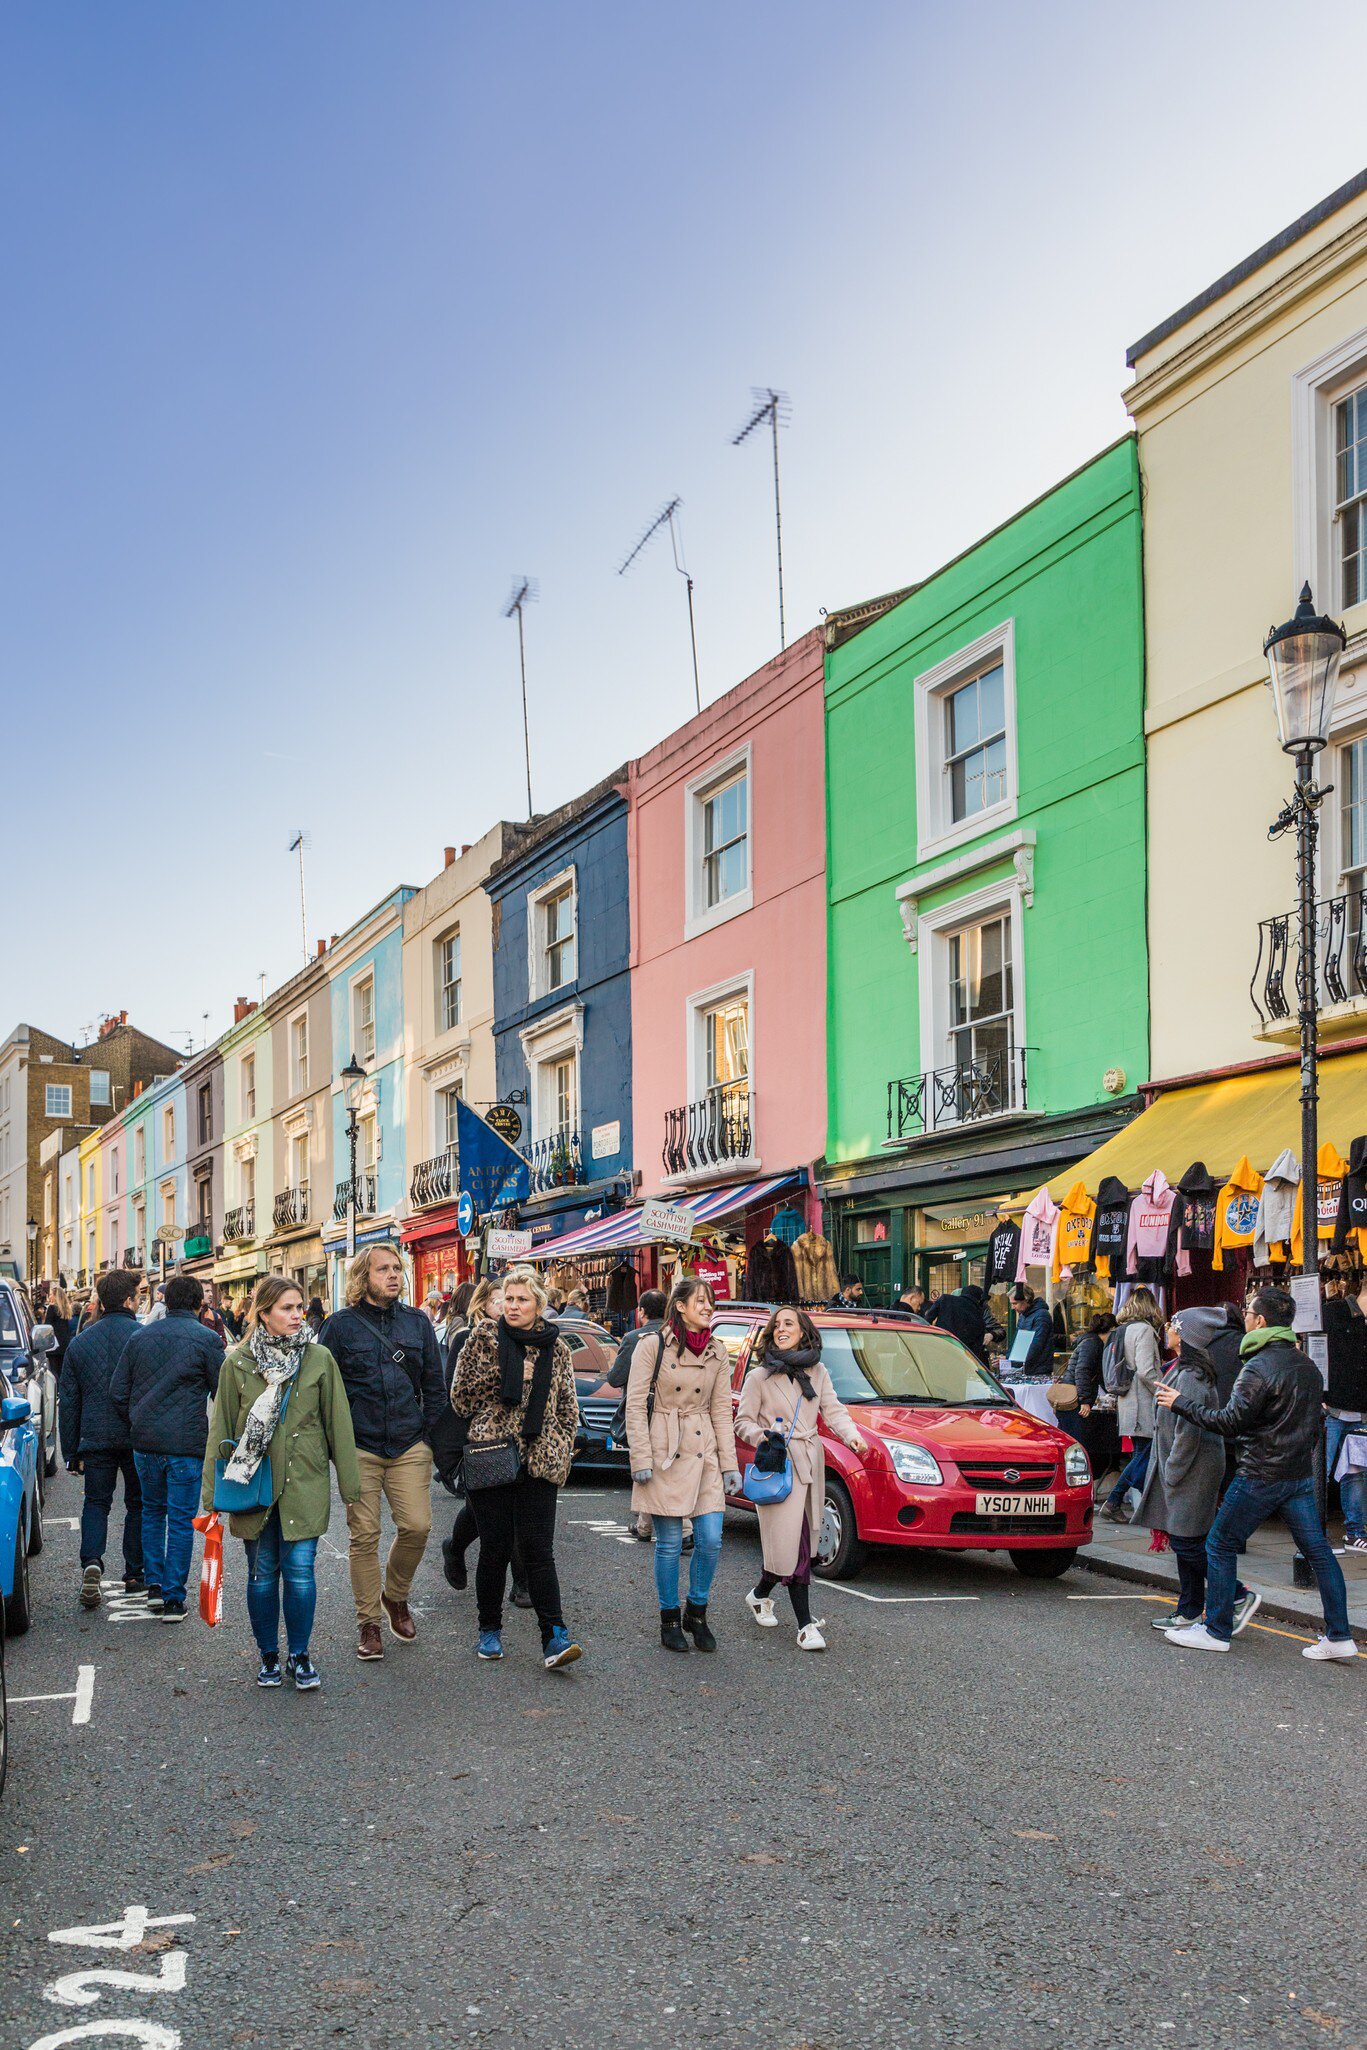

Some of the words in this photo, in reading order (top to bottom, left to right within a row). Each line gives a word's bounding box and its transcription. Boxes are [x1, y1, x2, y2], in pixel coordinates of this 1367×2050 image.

[467, 1164, 521, 1177] ANTIQUE
[650, 1209, 688, 1224] SCOTTISH
[941, 1216, 970, 1231] Gallery
[974, 1213, 984, 1227] 91
[1141, 1213, 1169, 1227] LONDON
[646, 1218, 688, 1235] CASHMERE
[1066, 1217, 1093, 1232] OXFORD
[161, 1228, 181, 1239] S&C
[494, 1236, 525, 1245] SCOTTISH
[983, 1497, 1021, 1512] YS07
[1024, 1497, 1050, 1512] NHH
